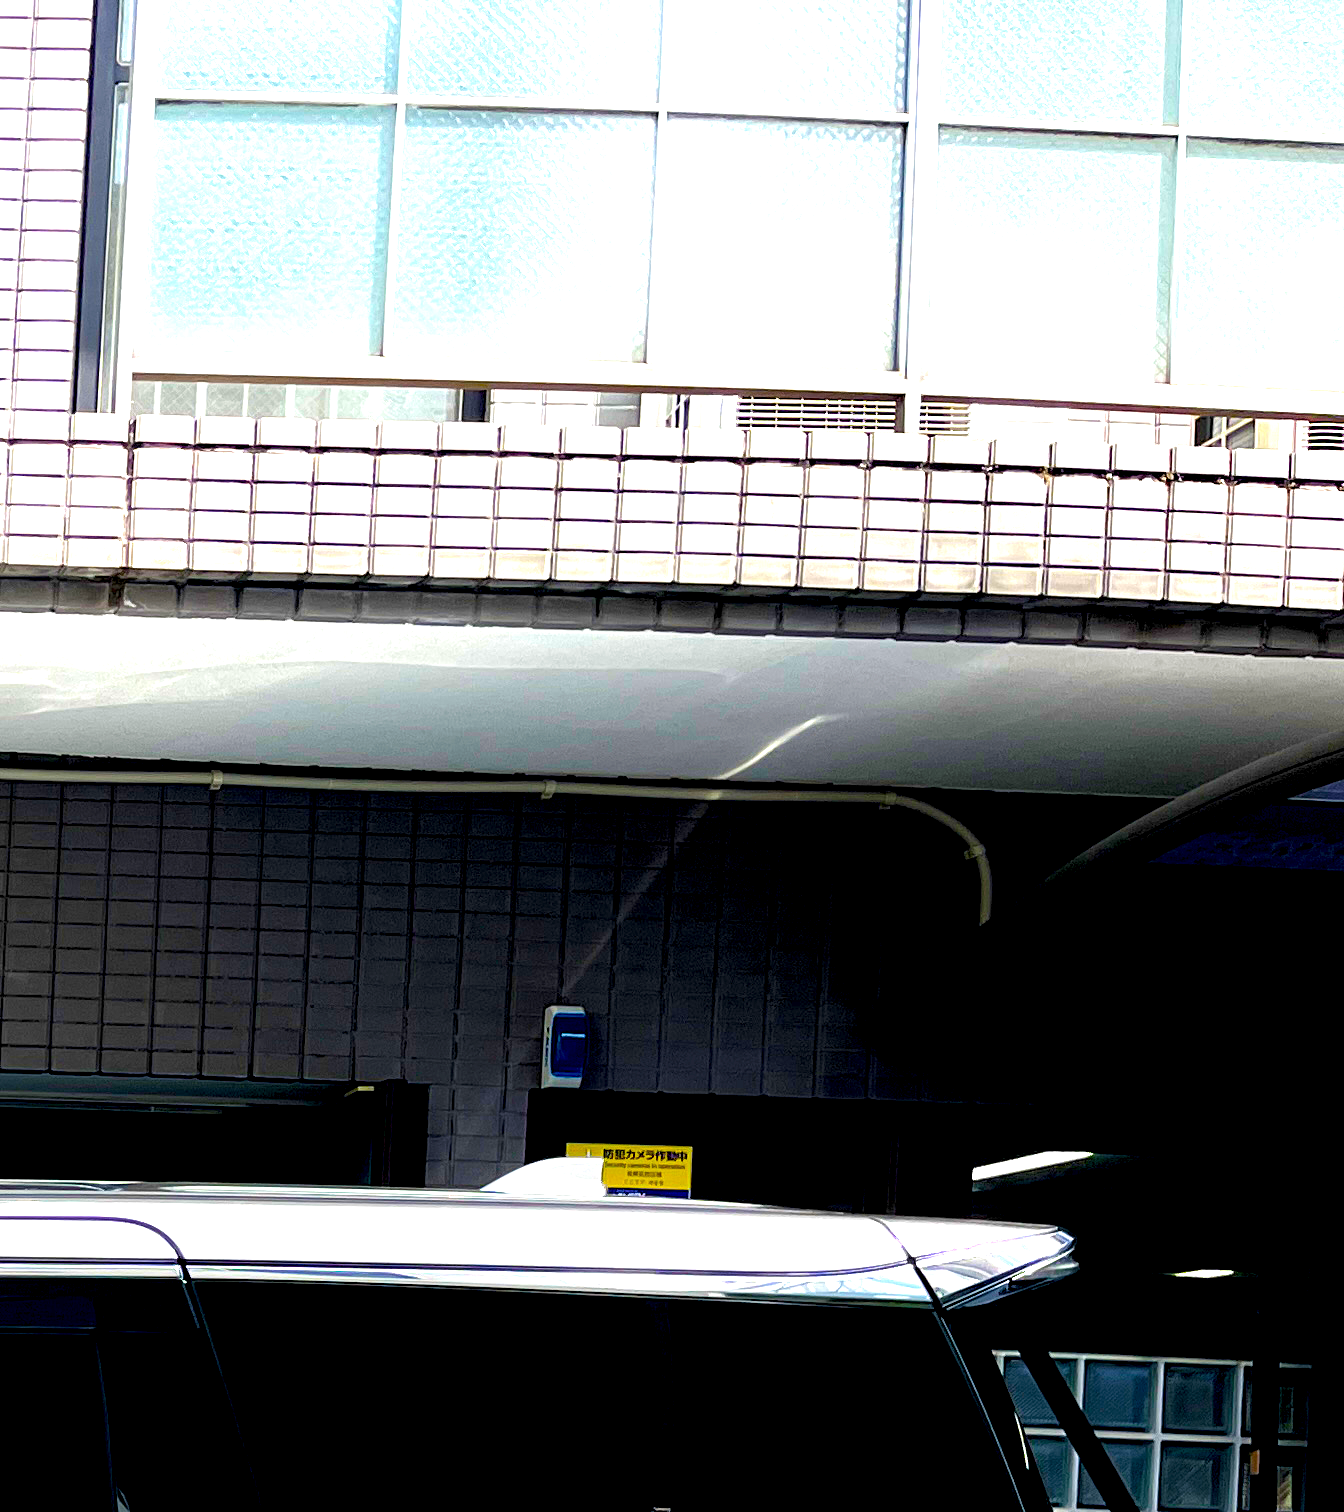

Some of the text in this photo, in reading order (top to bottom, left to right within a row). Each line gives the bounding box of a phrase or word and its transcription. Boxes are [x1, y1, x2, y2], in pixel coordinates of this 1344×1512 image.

[603, 1149, 688, 1162] 防犯カメラ作動中
